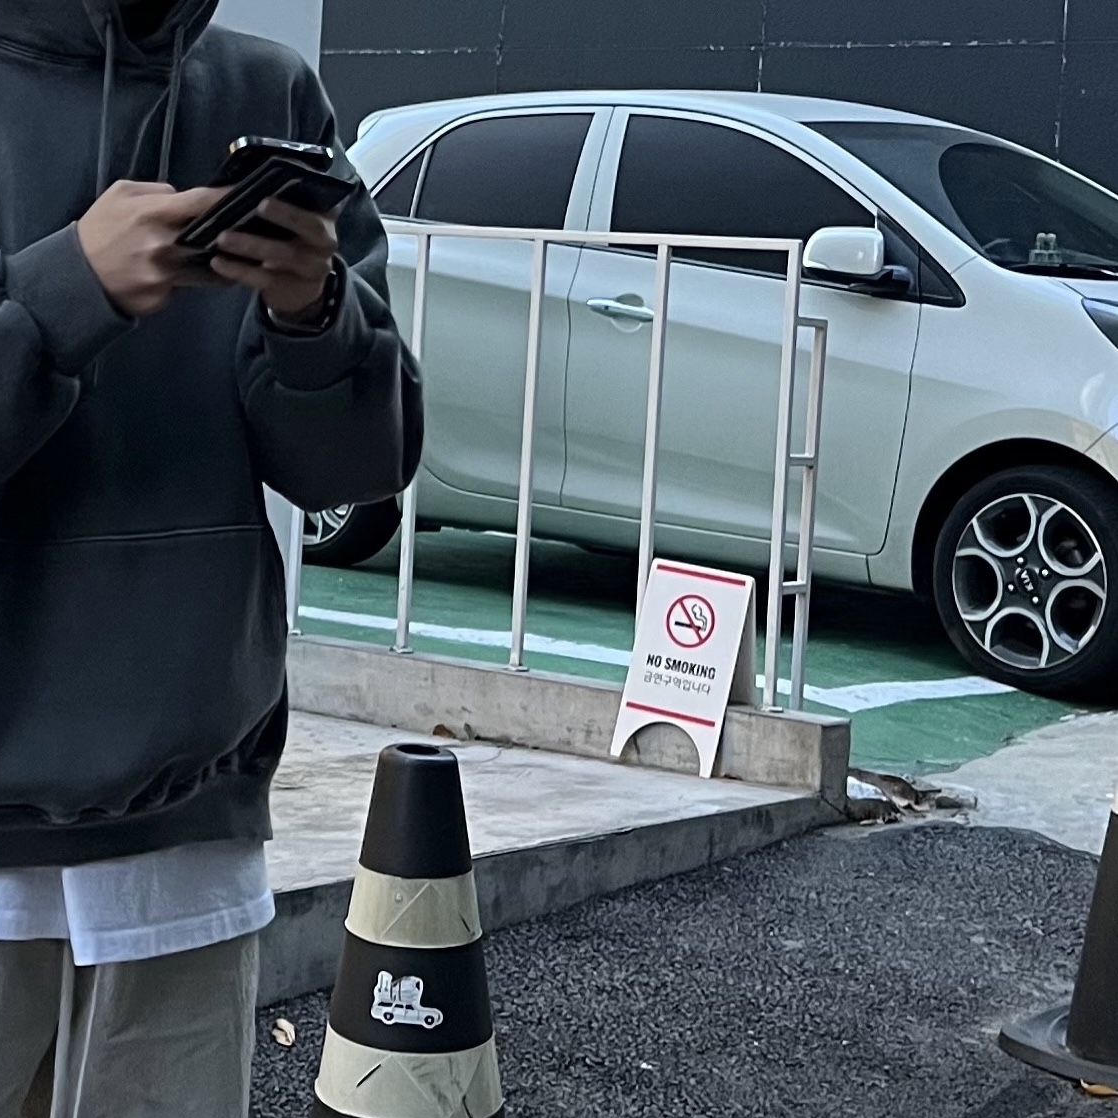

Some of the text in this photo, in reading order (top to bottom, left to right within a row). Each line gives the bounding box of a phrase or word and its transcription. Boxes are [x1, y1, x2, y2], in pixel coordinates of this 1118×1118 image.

[646, 653, 716, 680] NO SMOKING
[643, 670, 711, 695] 금연구역입니다
